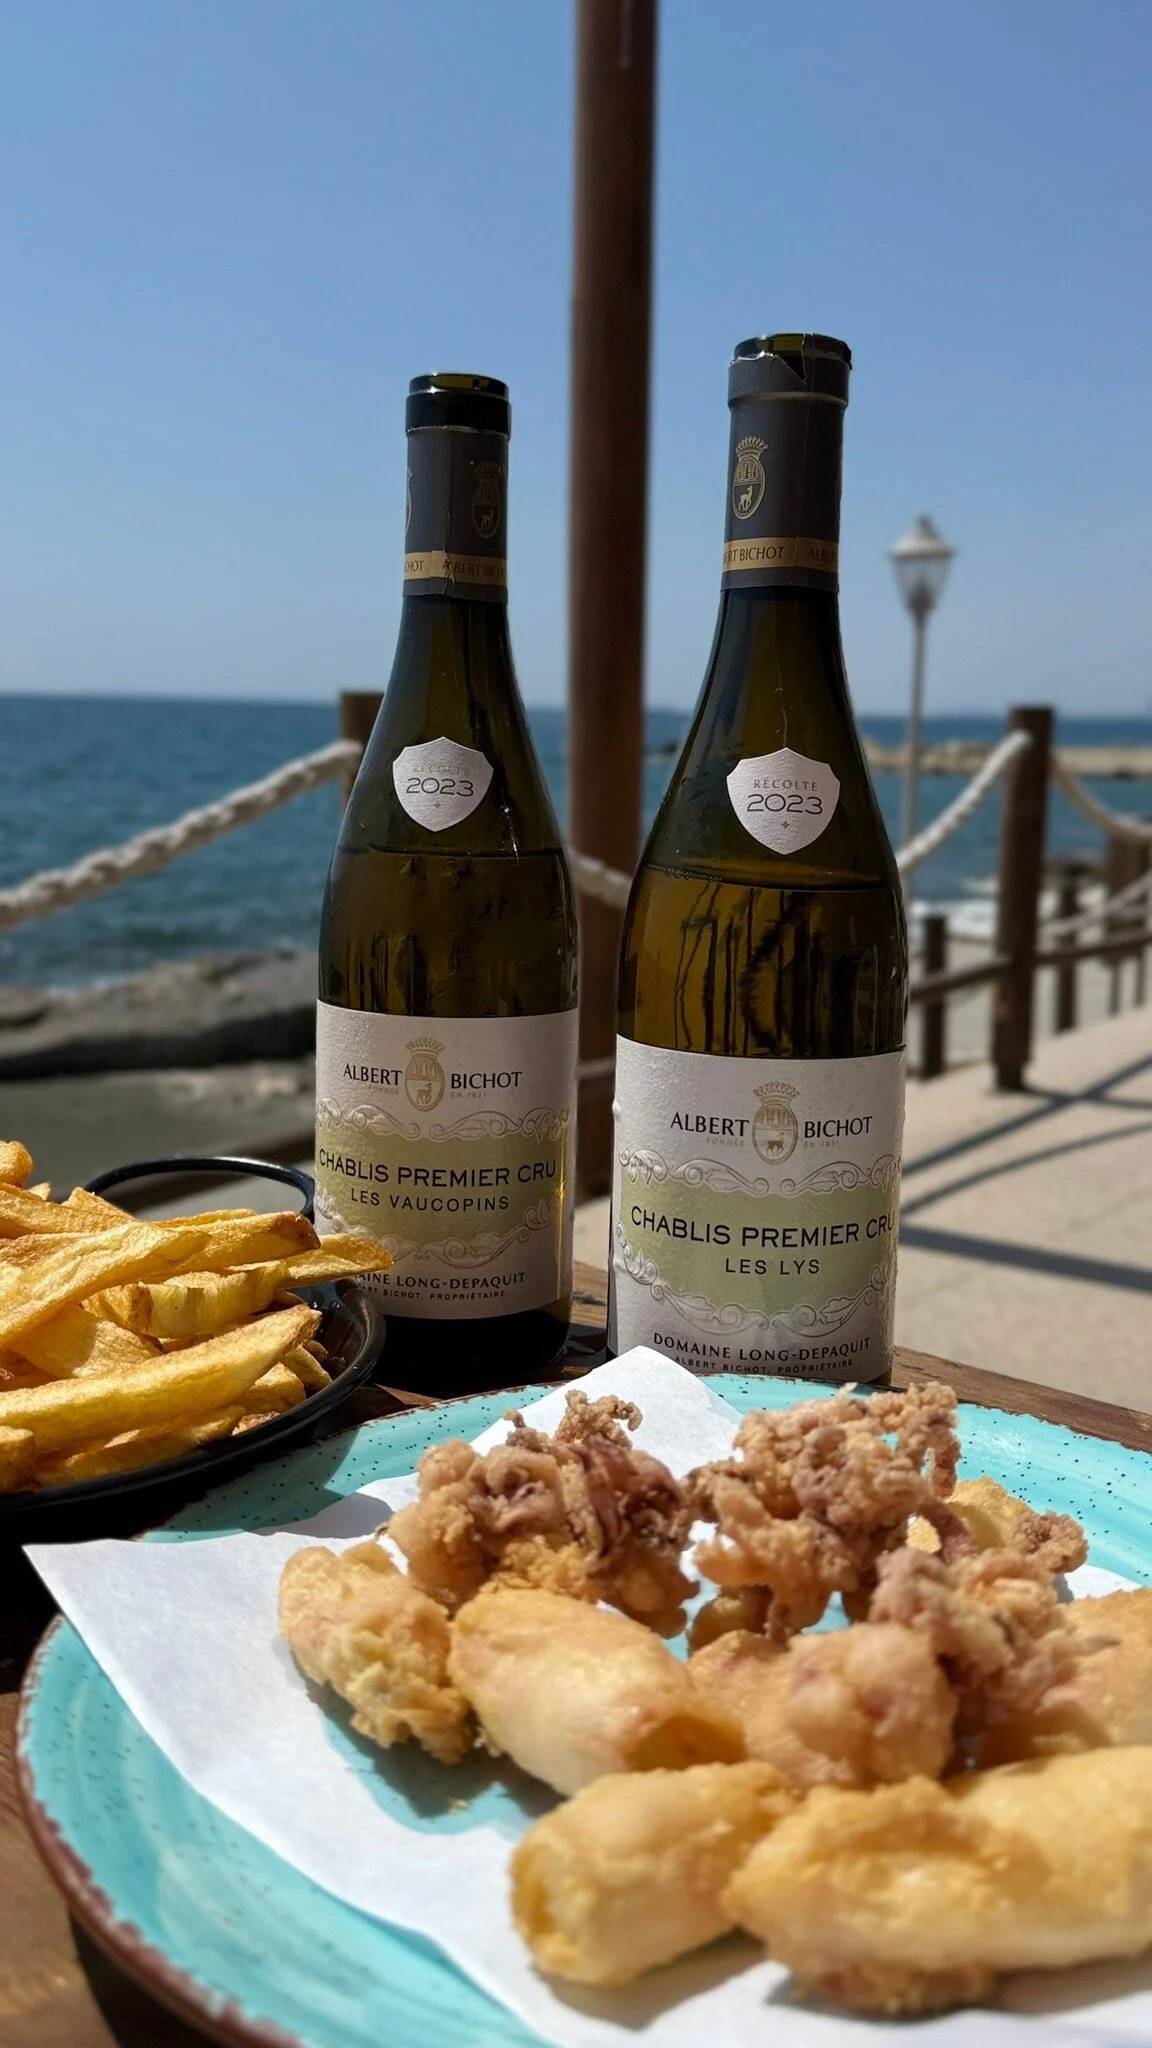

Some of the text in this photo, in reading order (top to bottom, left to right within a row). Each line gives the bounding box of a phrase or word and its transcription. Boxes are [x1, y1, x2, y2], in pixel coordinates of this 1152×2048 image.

[739, 546, 786, 562] BICHOT
[406, 777, 475, 797] 2023
[753, 776, 819, 793] RÉCOLTE
[747, 793, 824, 815] 2023
[343, 1063, 523, 1090] ALBERT BICHOT
[670, 1111, 873, 1139] ALBERT BICHOT
[706, 1136, 745, 1148] FONDÉE
[803, 1141, 817, 1149] EN
[319, 1147, 557, 1188] CHABLIS PREMIER CRU
[351, 1187, 510, 1212] LES VAUCOPINS
[631, 1205, 895, 1248] CHABLIS PREMIER CRU
[725, 1258, 820, 1275] LES LYS
[354, 1272, 526, 1290] AINE LONG-DEPAQUIT
[430, 1289, 505, 1300] PROPRIÉTAIRE
[653, 1332, 871, 1362] DOMAINE LONG-DEPAQUIT
[675, 1356, 716, 1370] ALBERT
[777, 1358, 854, 1373] PROPRIÉTAIRE
